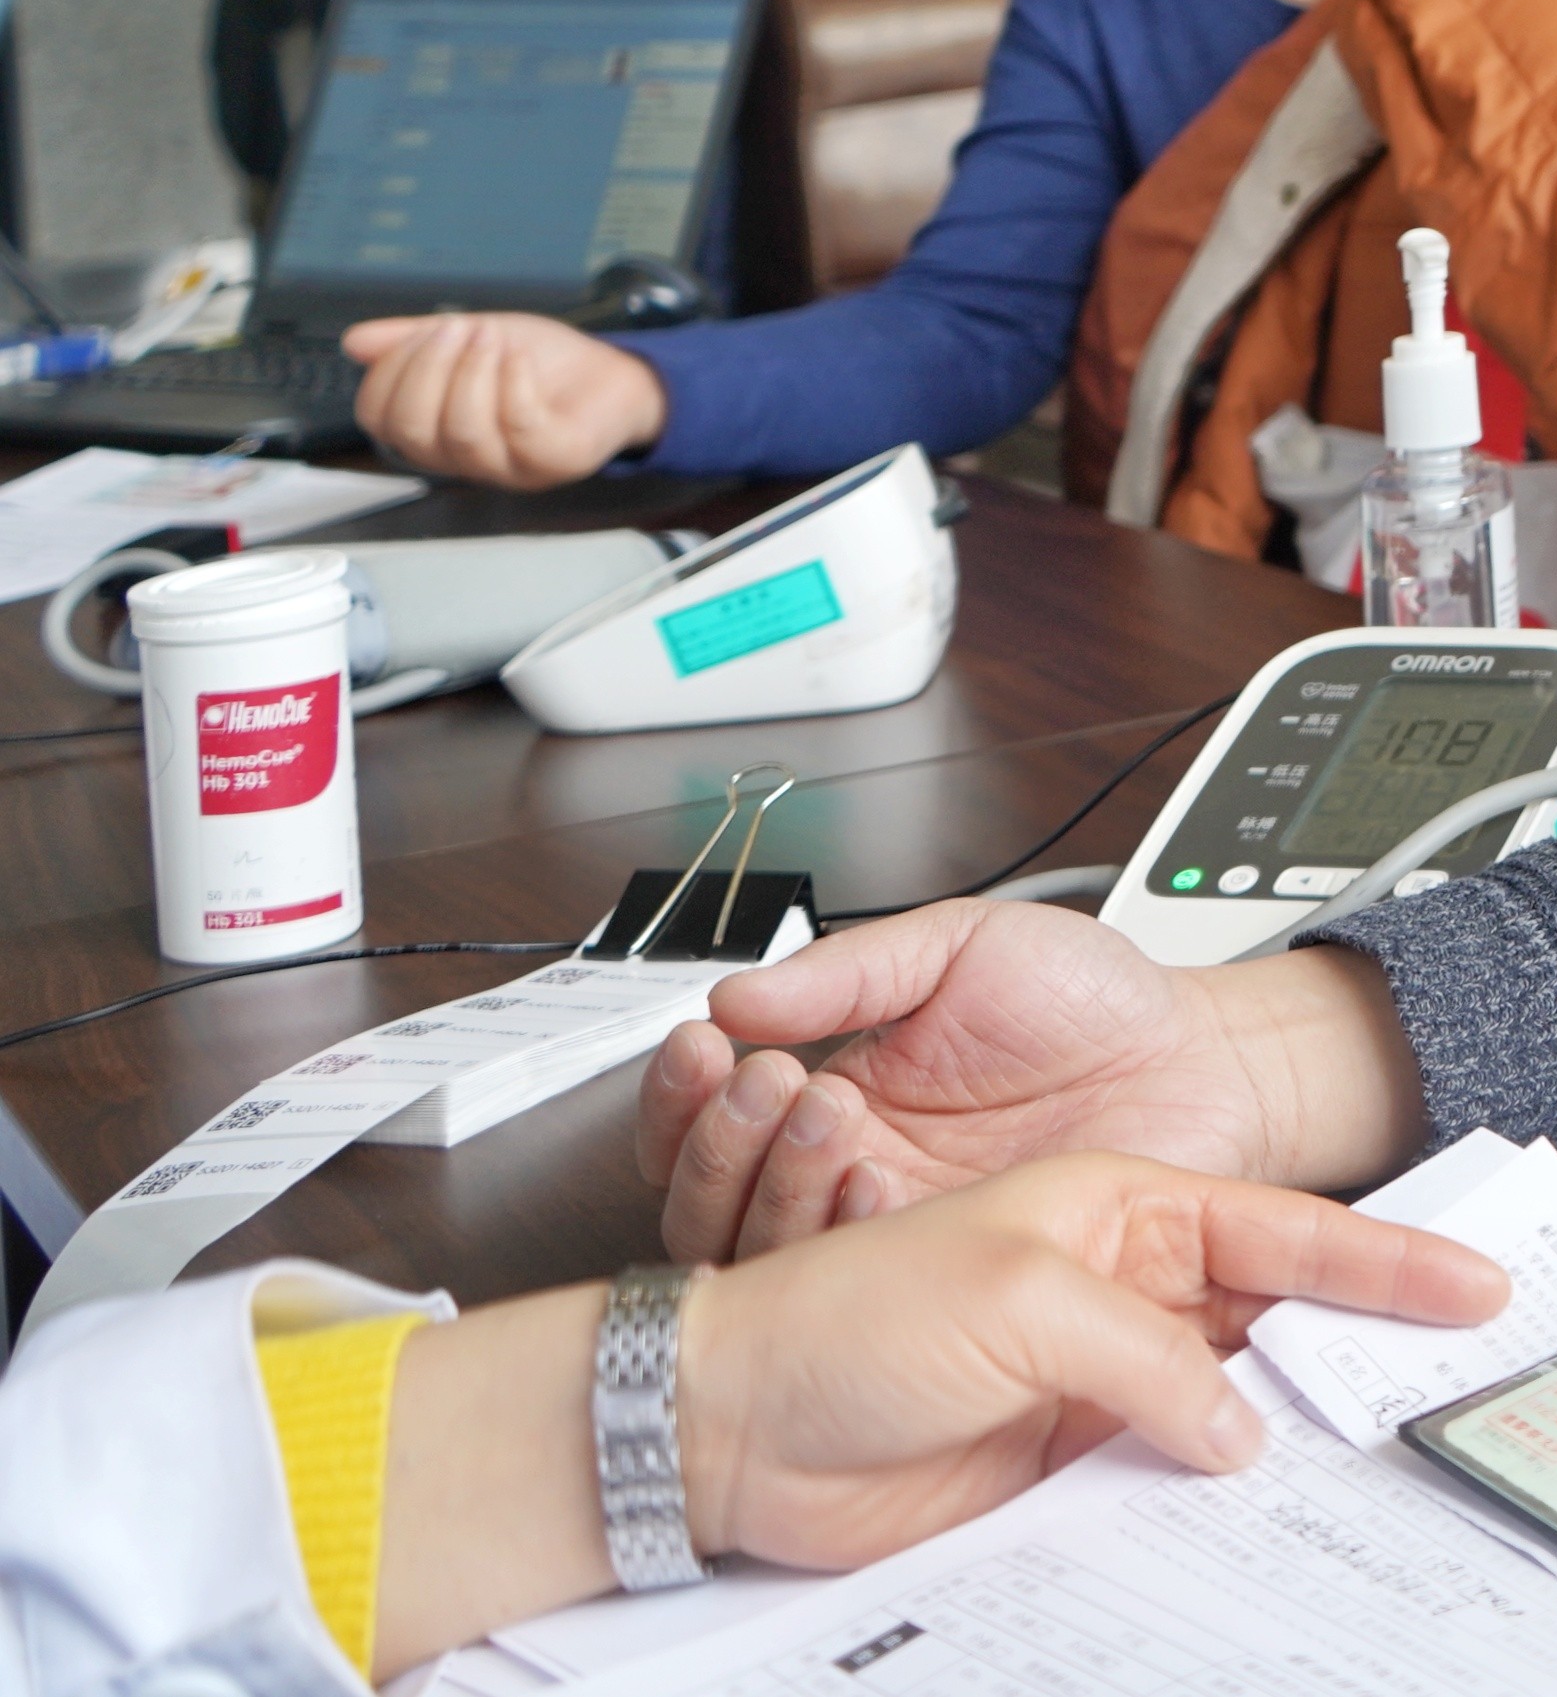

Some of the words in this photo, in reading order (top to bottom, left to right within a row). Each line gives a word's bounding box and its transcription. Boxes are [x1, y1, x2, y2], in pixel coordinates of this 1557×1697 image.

[1390, 653, 1496, 674] OMRON
[202, 774, 232, 793] Hb
[233, 770, 271, 791] 301
[206, 914, 233, 928] Hb
